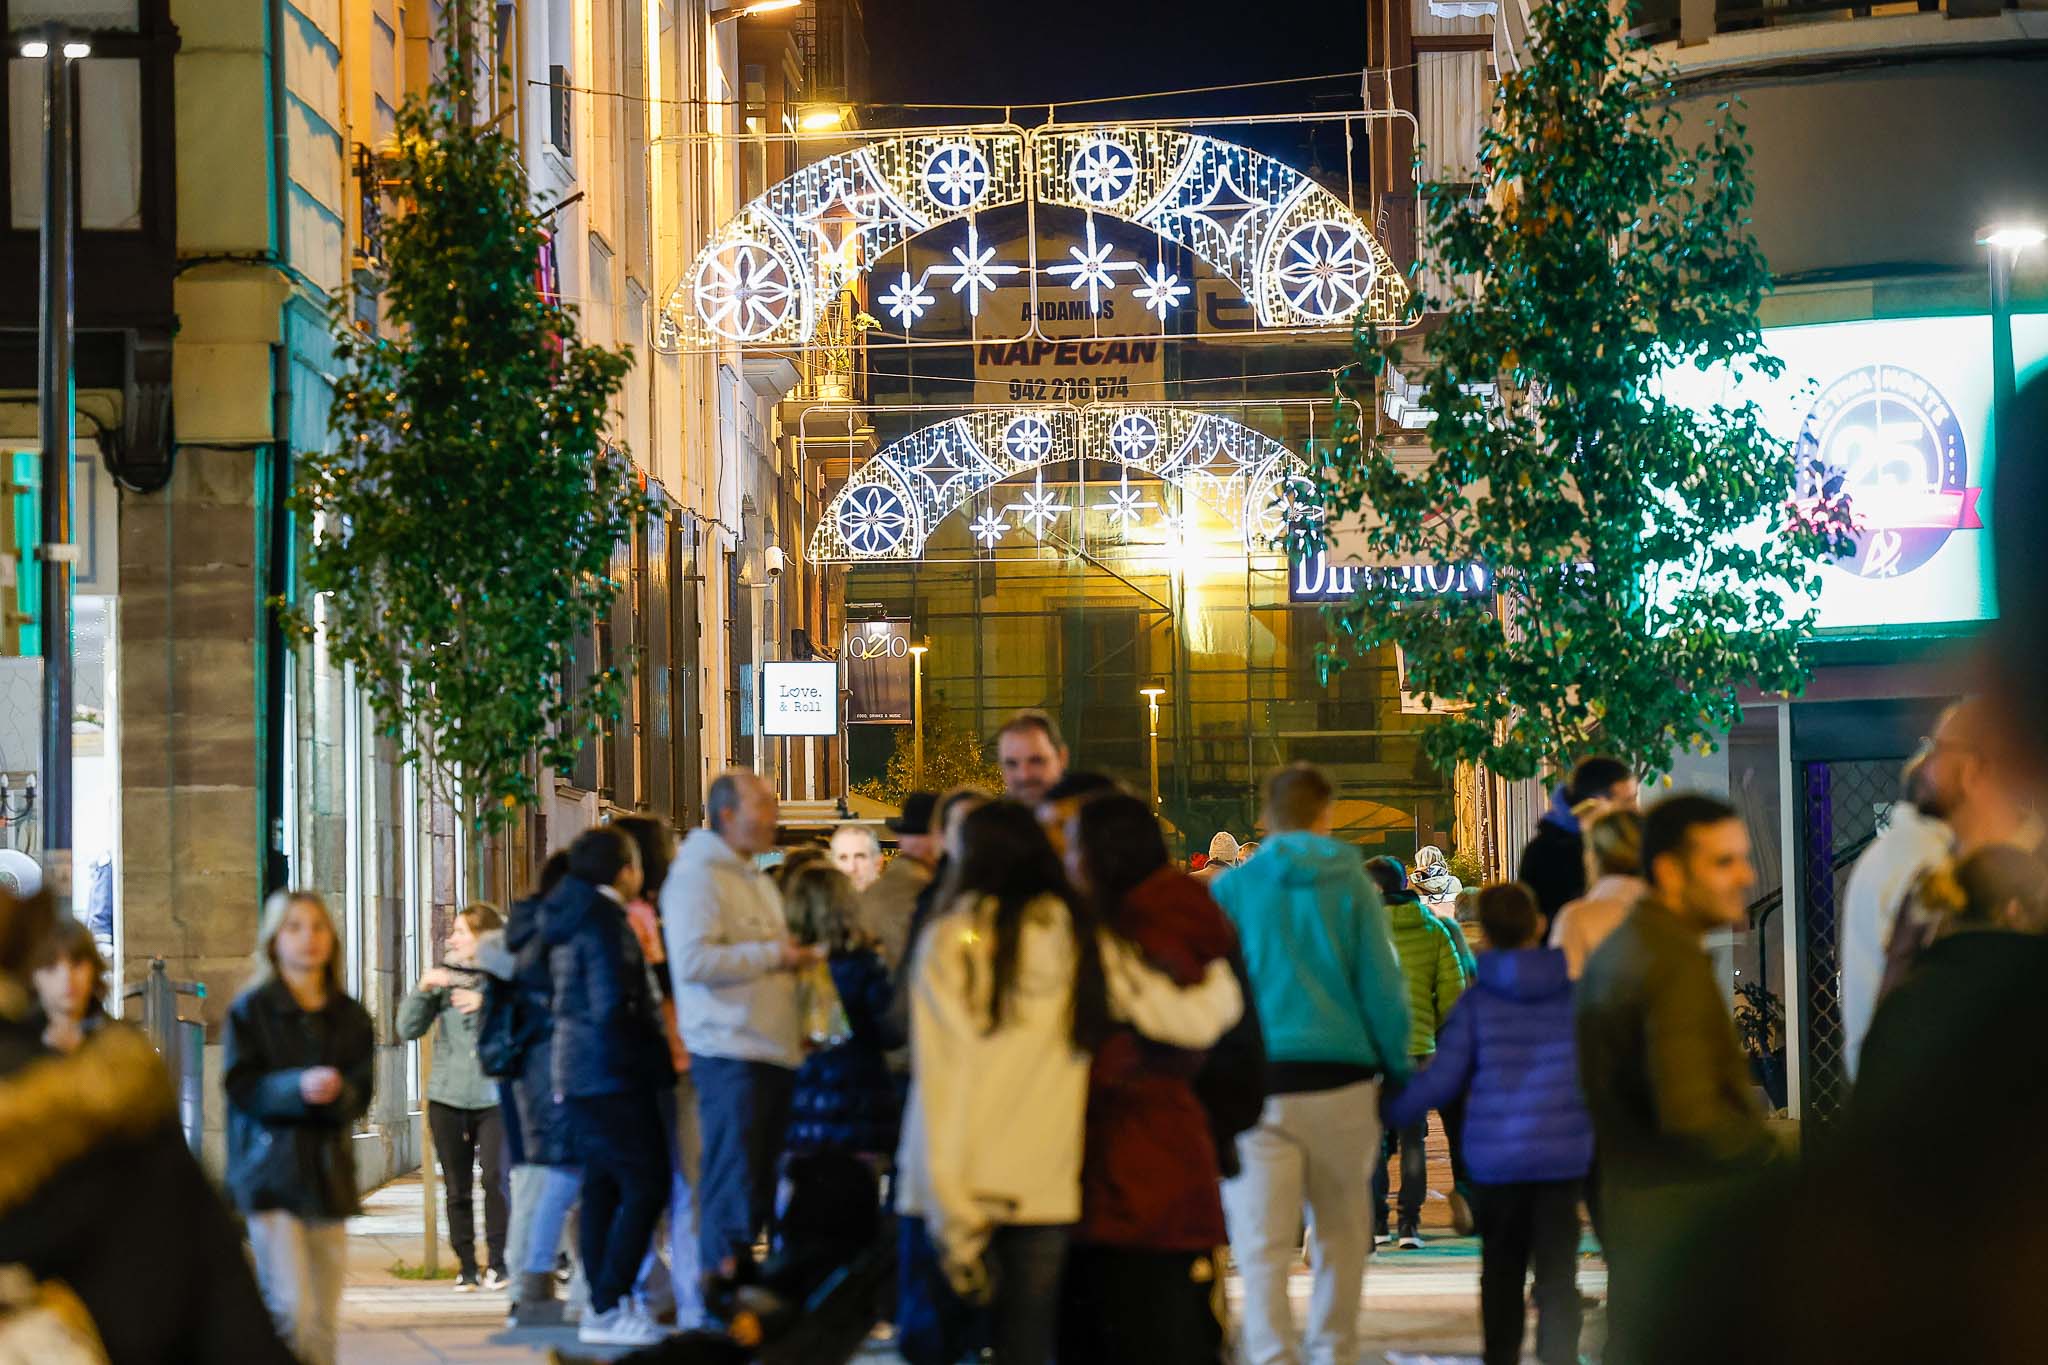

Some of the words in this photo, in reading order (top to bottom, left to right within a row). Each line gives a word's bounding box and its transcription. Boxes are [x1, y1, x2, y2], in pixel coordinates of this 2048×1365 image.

[978, 333, 1159, 366] NAPECAN
[1009, 378, 1047, 401] 942
[1096, 376, 1129, 399] 574
[779, 701, 788, 712] &
[794, 701, 822, 712] Roll
